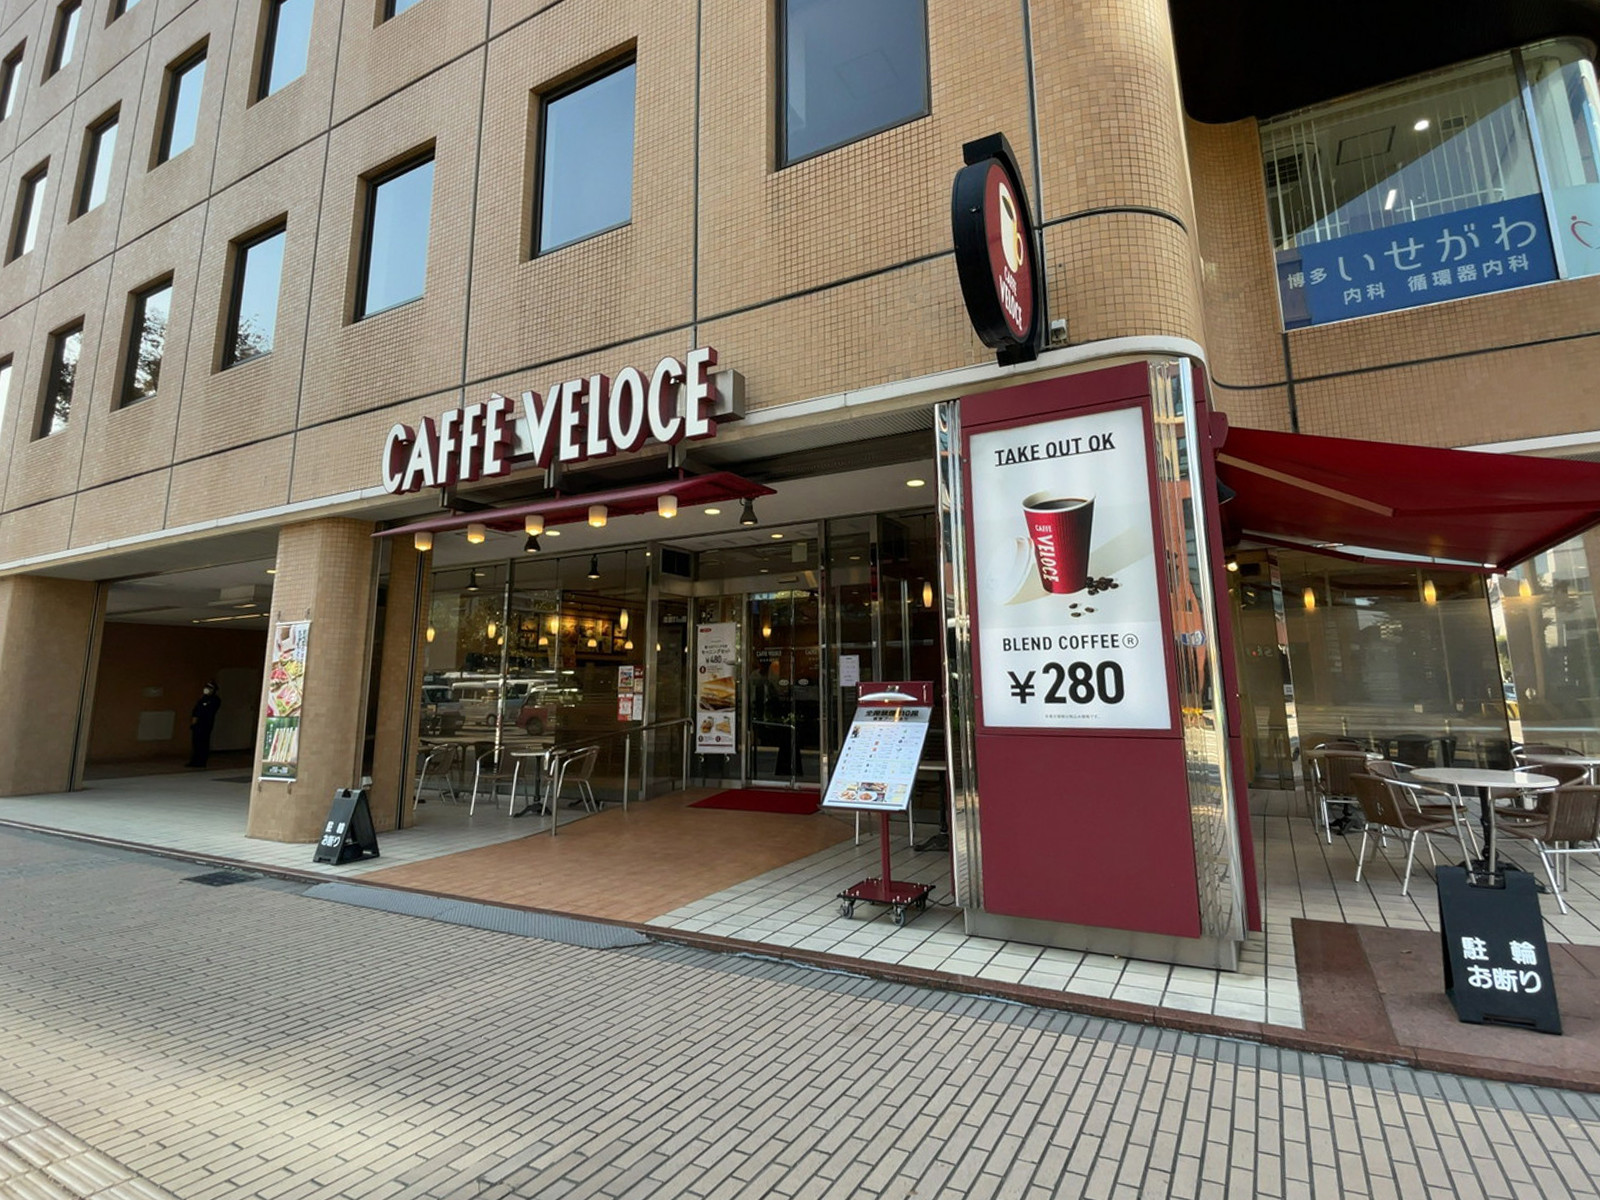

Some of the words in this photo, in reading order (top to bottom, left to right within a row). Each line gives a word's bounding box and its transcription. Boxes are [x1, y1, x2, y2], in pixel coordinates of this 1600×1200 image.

[1338, 215, 1538, 282] いせがわ
[1287, 267, 1328, 290] 博多
[1343, 282, 1386, 305] 内科
[1407, 254, 1530, 293] 循環器内科
[522, 346, 718, 467] VELOCE
[995, 444, 1040, 466] TAKE
[1046, 438, 1082, 458] OUT
[1089, 432, 1116, 451] OK
[1037, 535, 1060, 582] VELOCE
[1003, 636, 1052, 651] BLEND
[1007, 660, 1125, 705] ¥280
[1467, 965, 1542, 994] お断り
